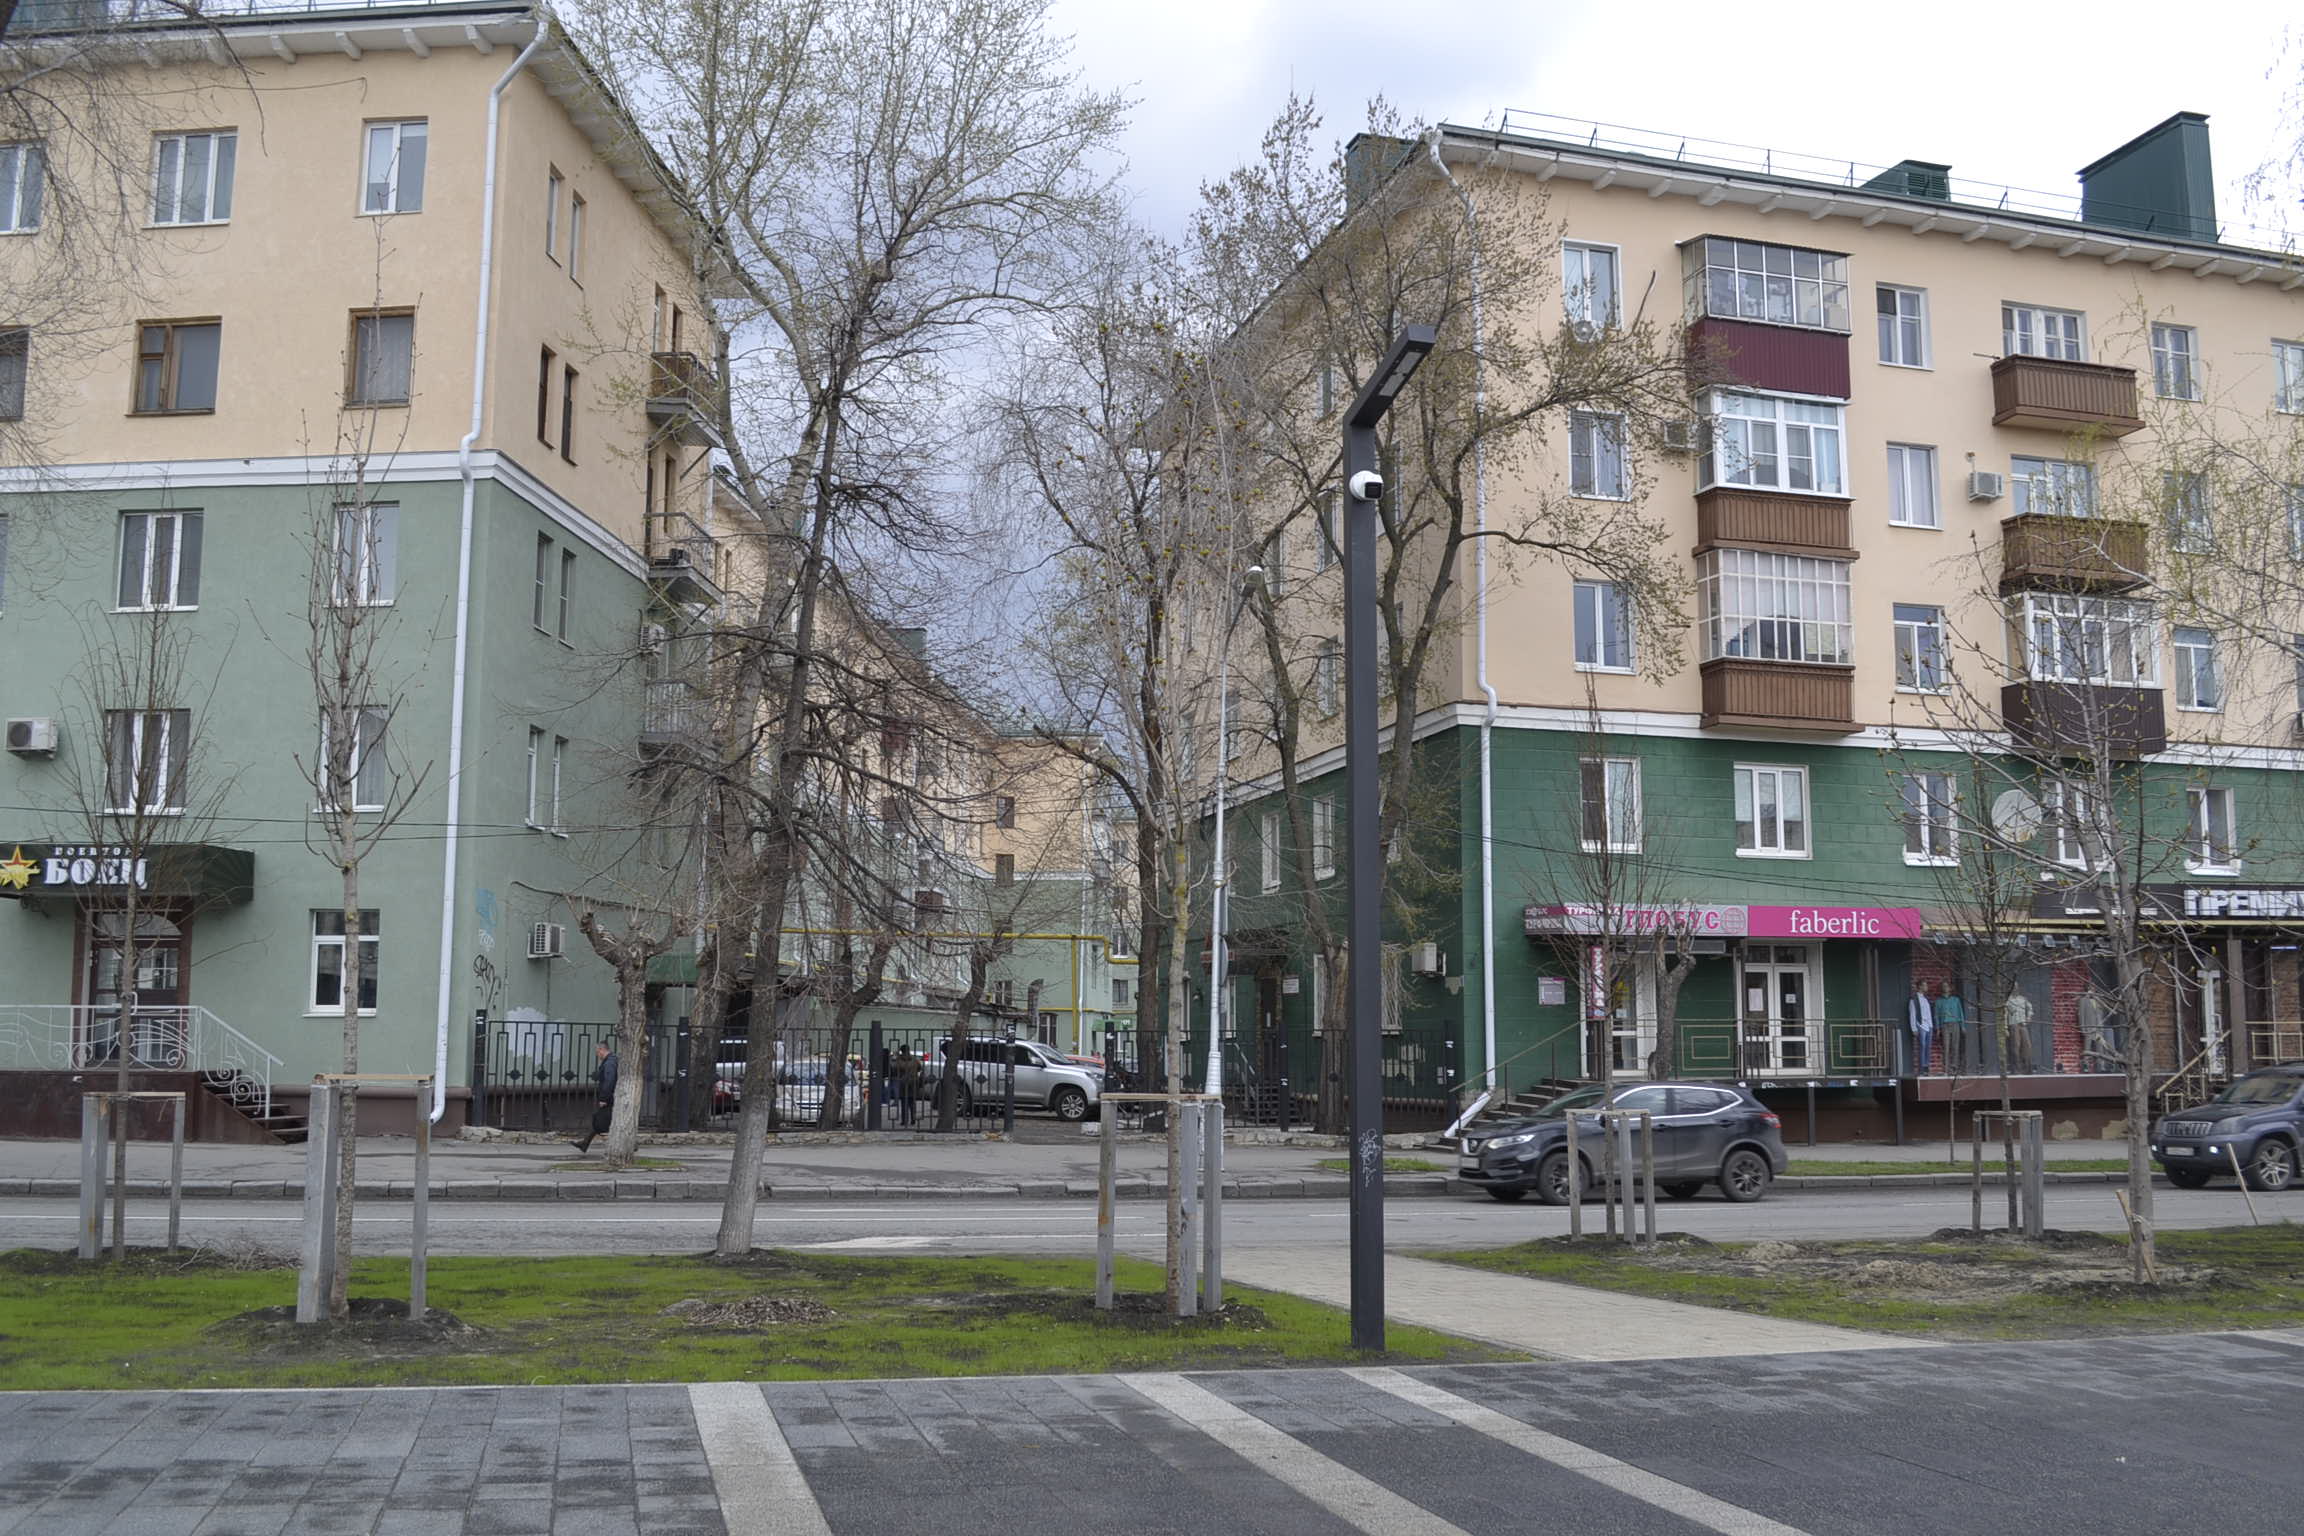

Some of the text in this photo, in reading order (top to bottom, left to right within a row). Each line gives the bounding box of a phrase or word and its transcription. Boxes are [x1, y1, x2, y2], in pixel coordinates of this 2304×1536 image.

[55, 847, 143, 856] ВОЕНТОР
[44, 858, 148, 890] БОЕЦ
[1624, 909, 1720, 930] ГЛОБУС
[1789, 909, 1881, 934] faberlic
